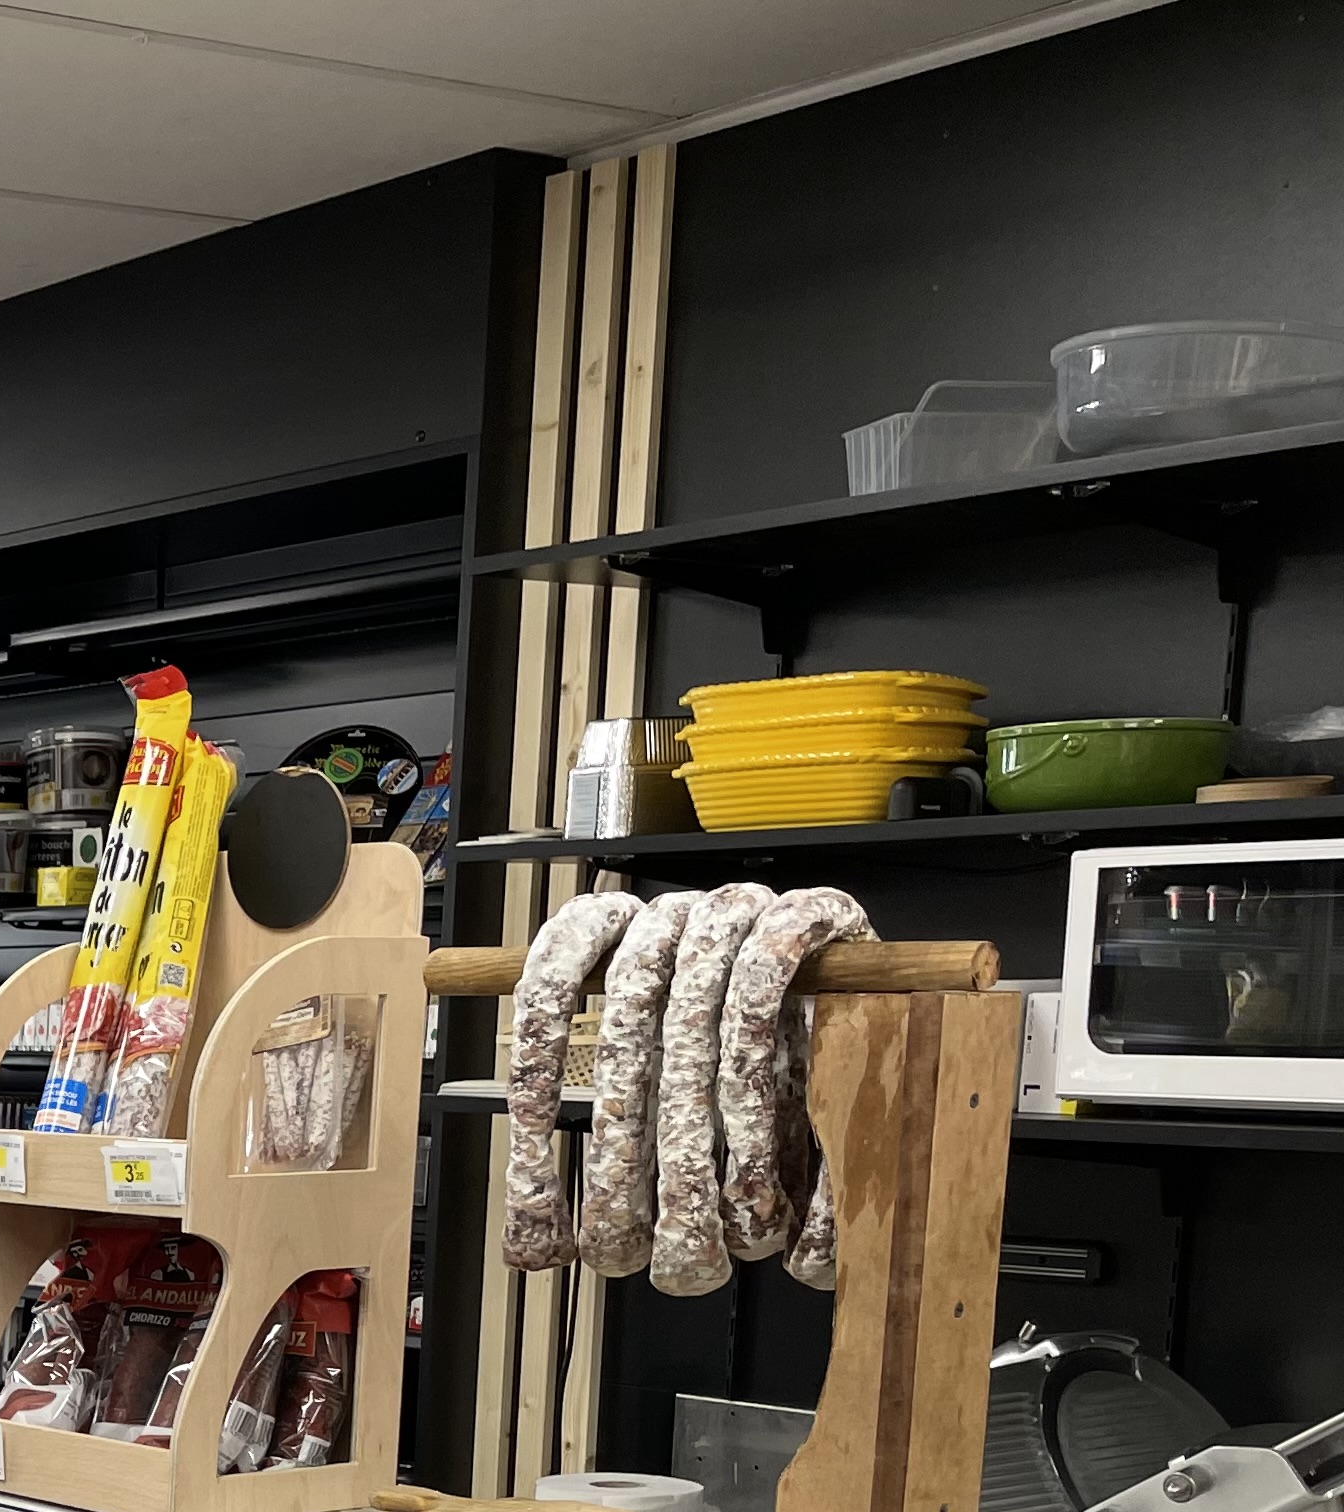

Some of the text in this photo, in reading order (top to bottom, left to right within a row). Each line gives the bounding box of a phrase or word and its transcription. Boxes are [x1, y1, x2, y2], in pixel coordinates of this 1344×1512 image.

[118, 801, 133, 829] le
[41, 840, 71, 850] bouch
[129, 1312, 172, 1327] CHORIZO
